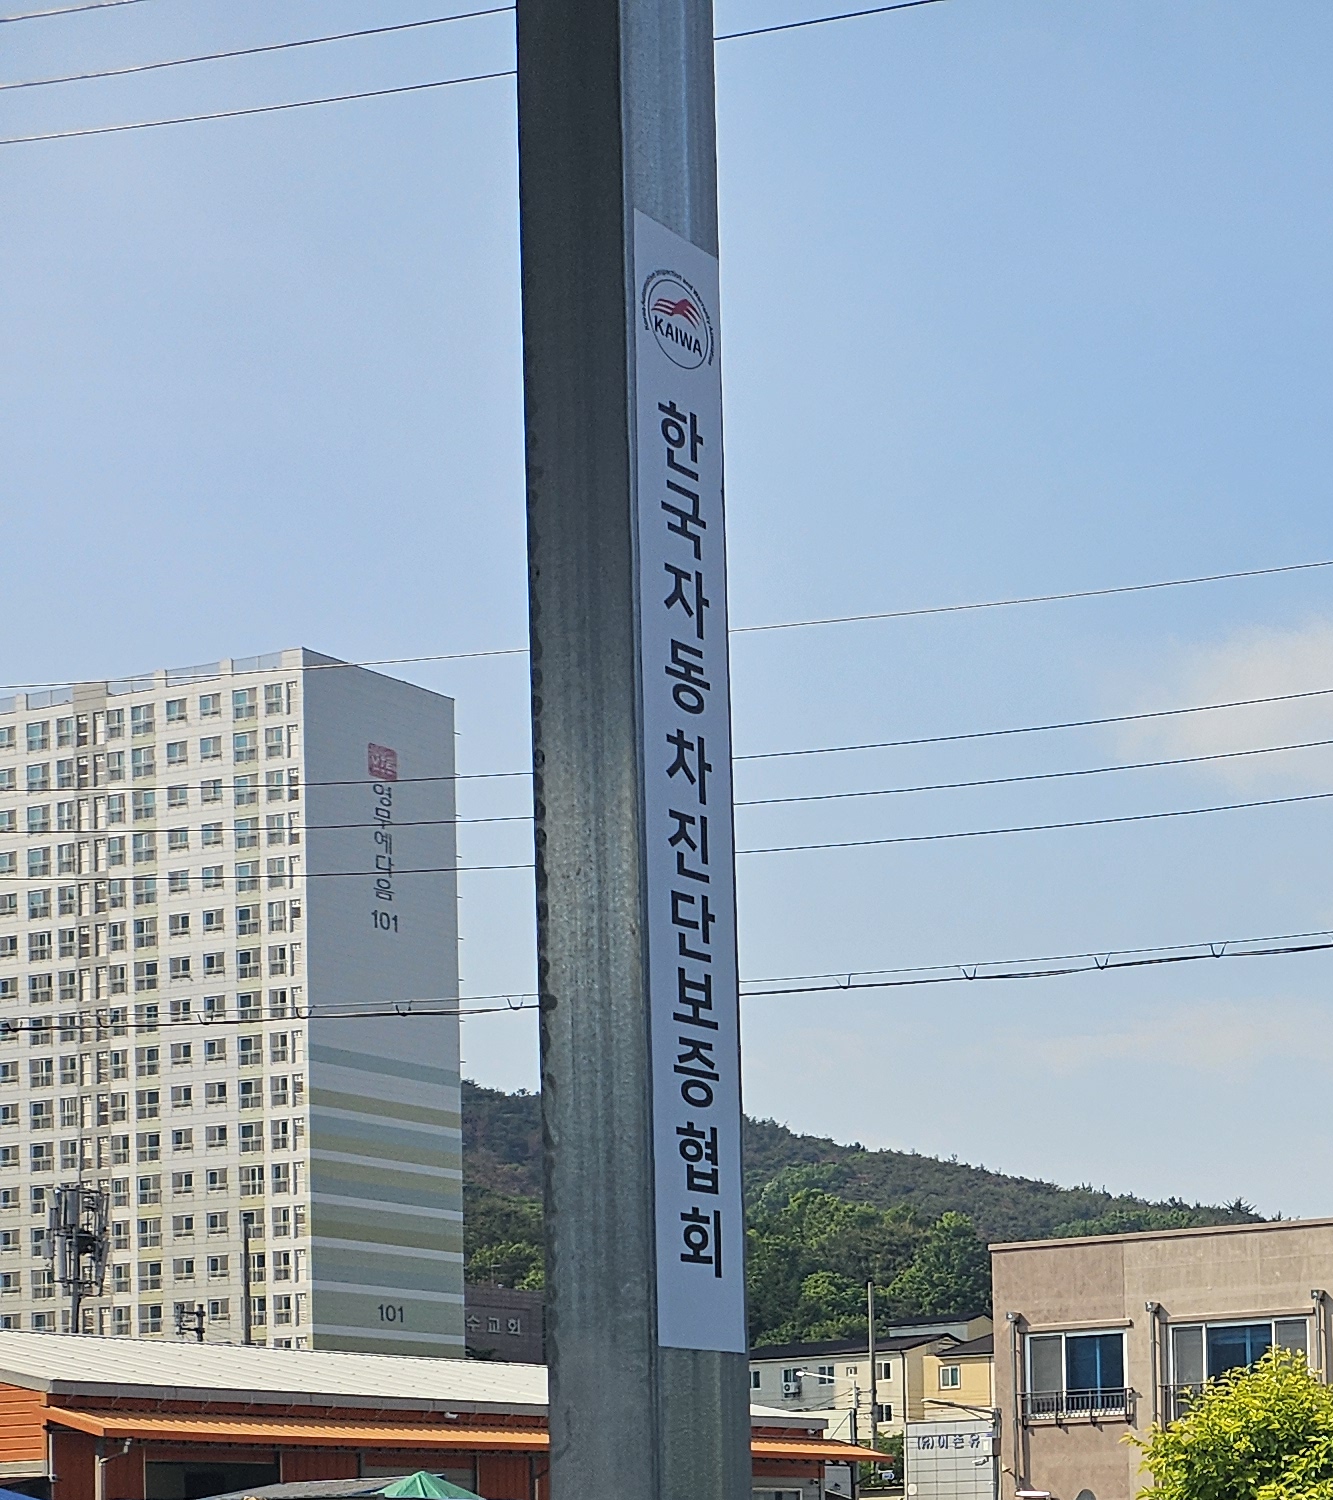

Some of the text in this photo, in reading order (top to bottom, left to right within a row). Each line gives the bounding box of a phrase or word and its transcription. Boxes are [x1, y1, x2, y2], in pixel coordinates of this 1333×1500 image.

[654, 315, 703, 358] KAIWA
[658, 400, 722, 1279] 한국자동차진단보증협회
[371, 909, 399, 933] 101
[378, 1304, 404, 1323] 101
